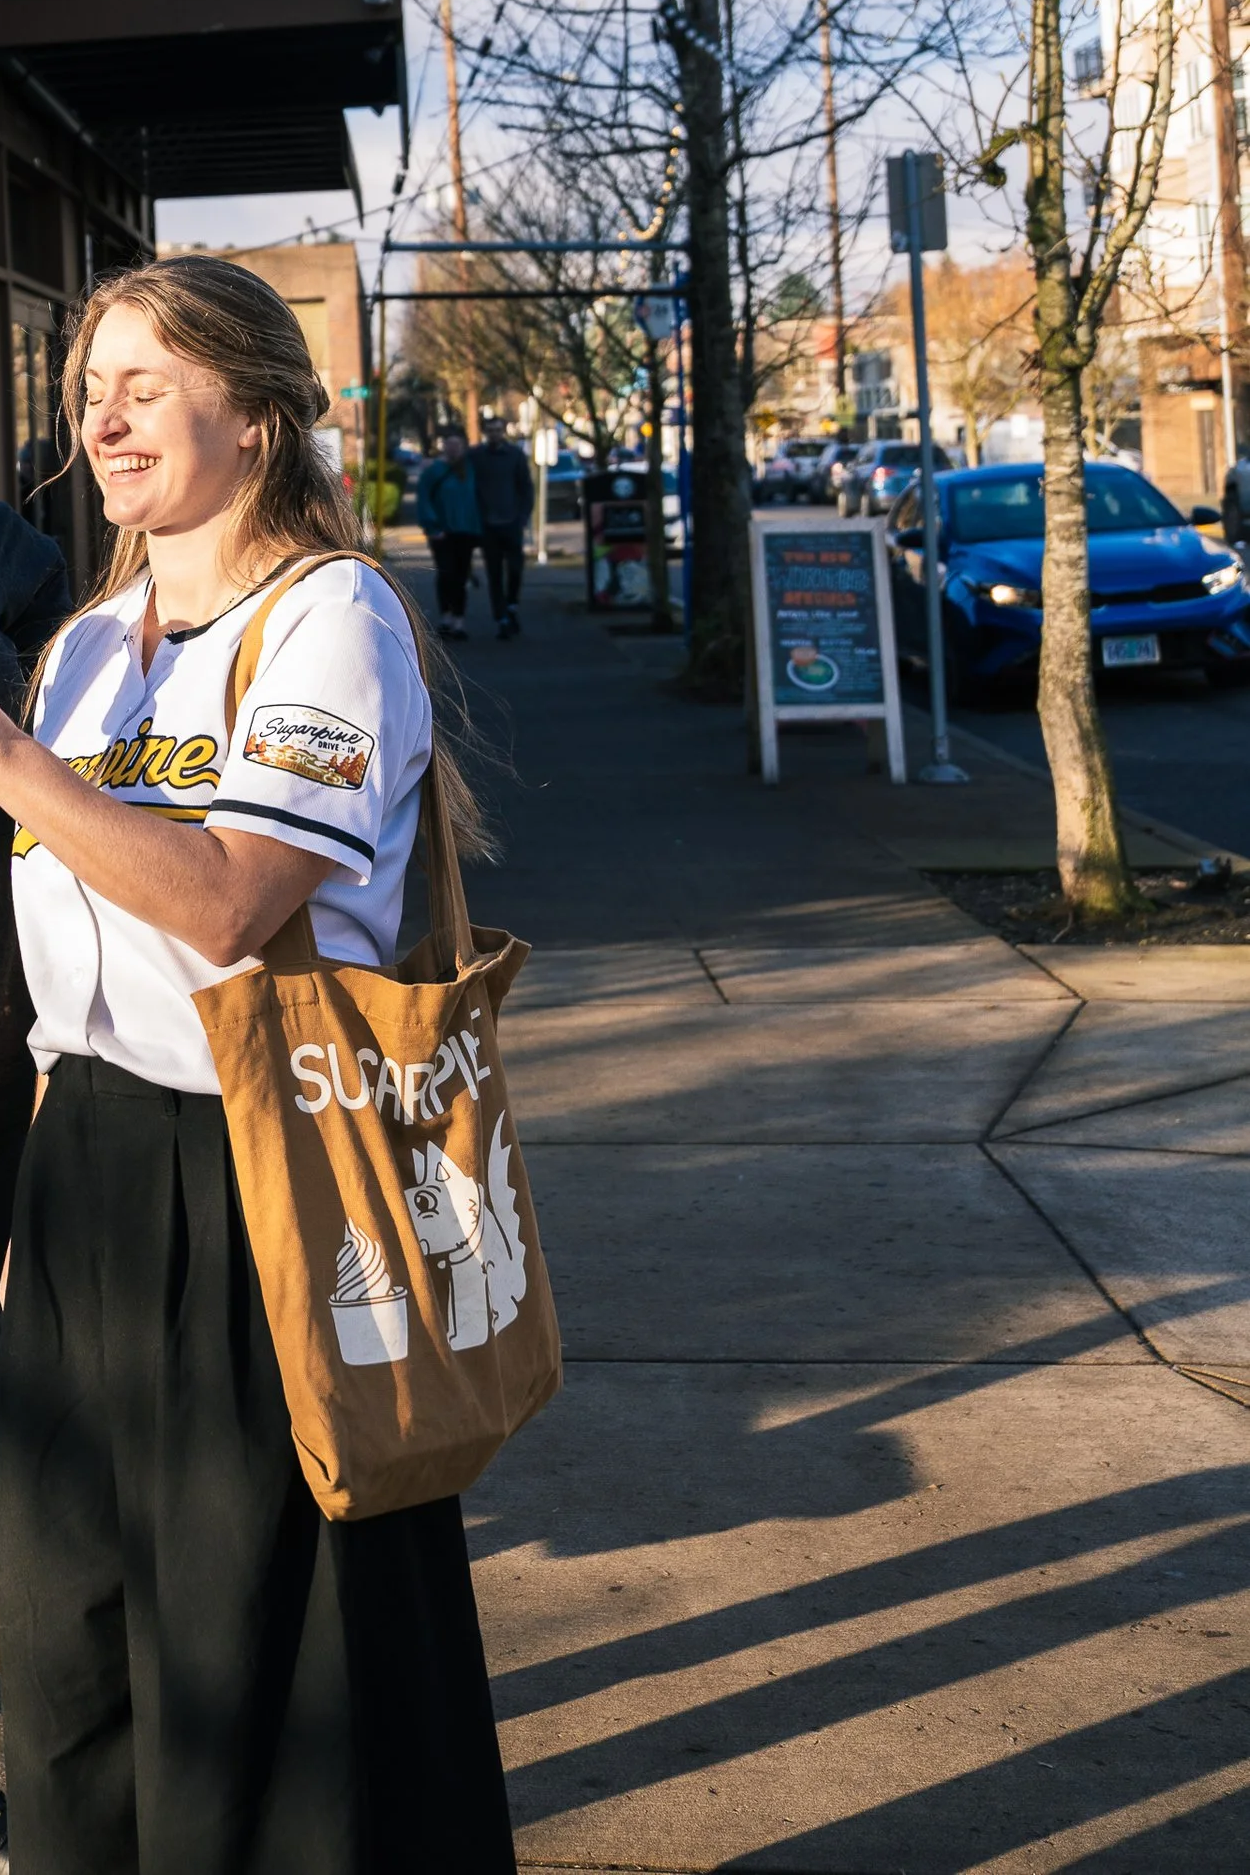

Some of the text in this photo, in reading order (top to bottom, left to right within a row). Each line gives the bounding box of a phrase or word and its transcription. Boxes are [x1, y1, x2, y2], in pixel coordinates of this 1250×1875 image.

[259, 717, 365, 745] Sugarpine
[317, 740, 339, 752] DRIVE
[347, 746, 356, 754] IN
